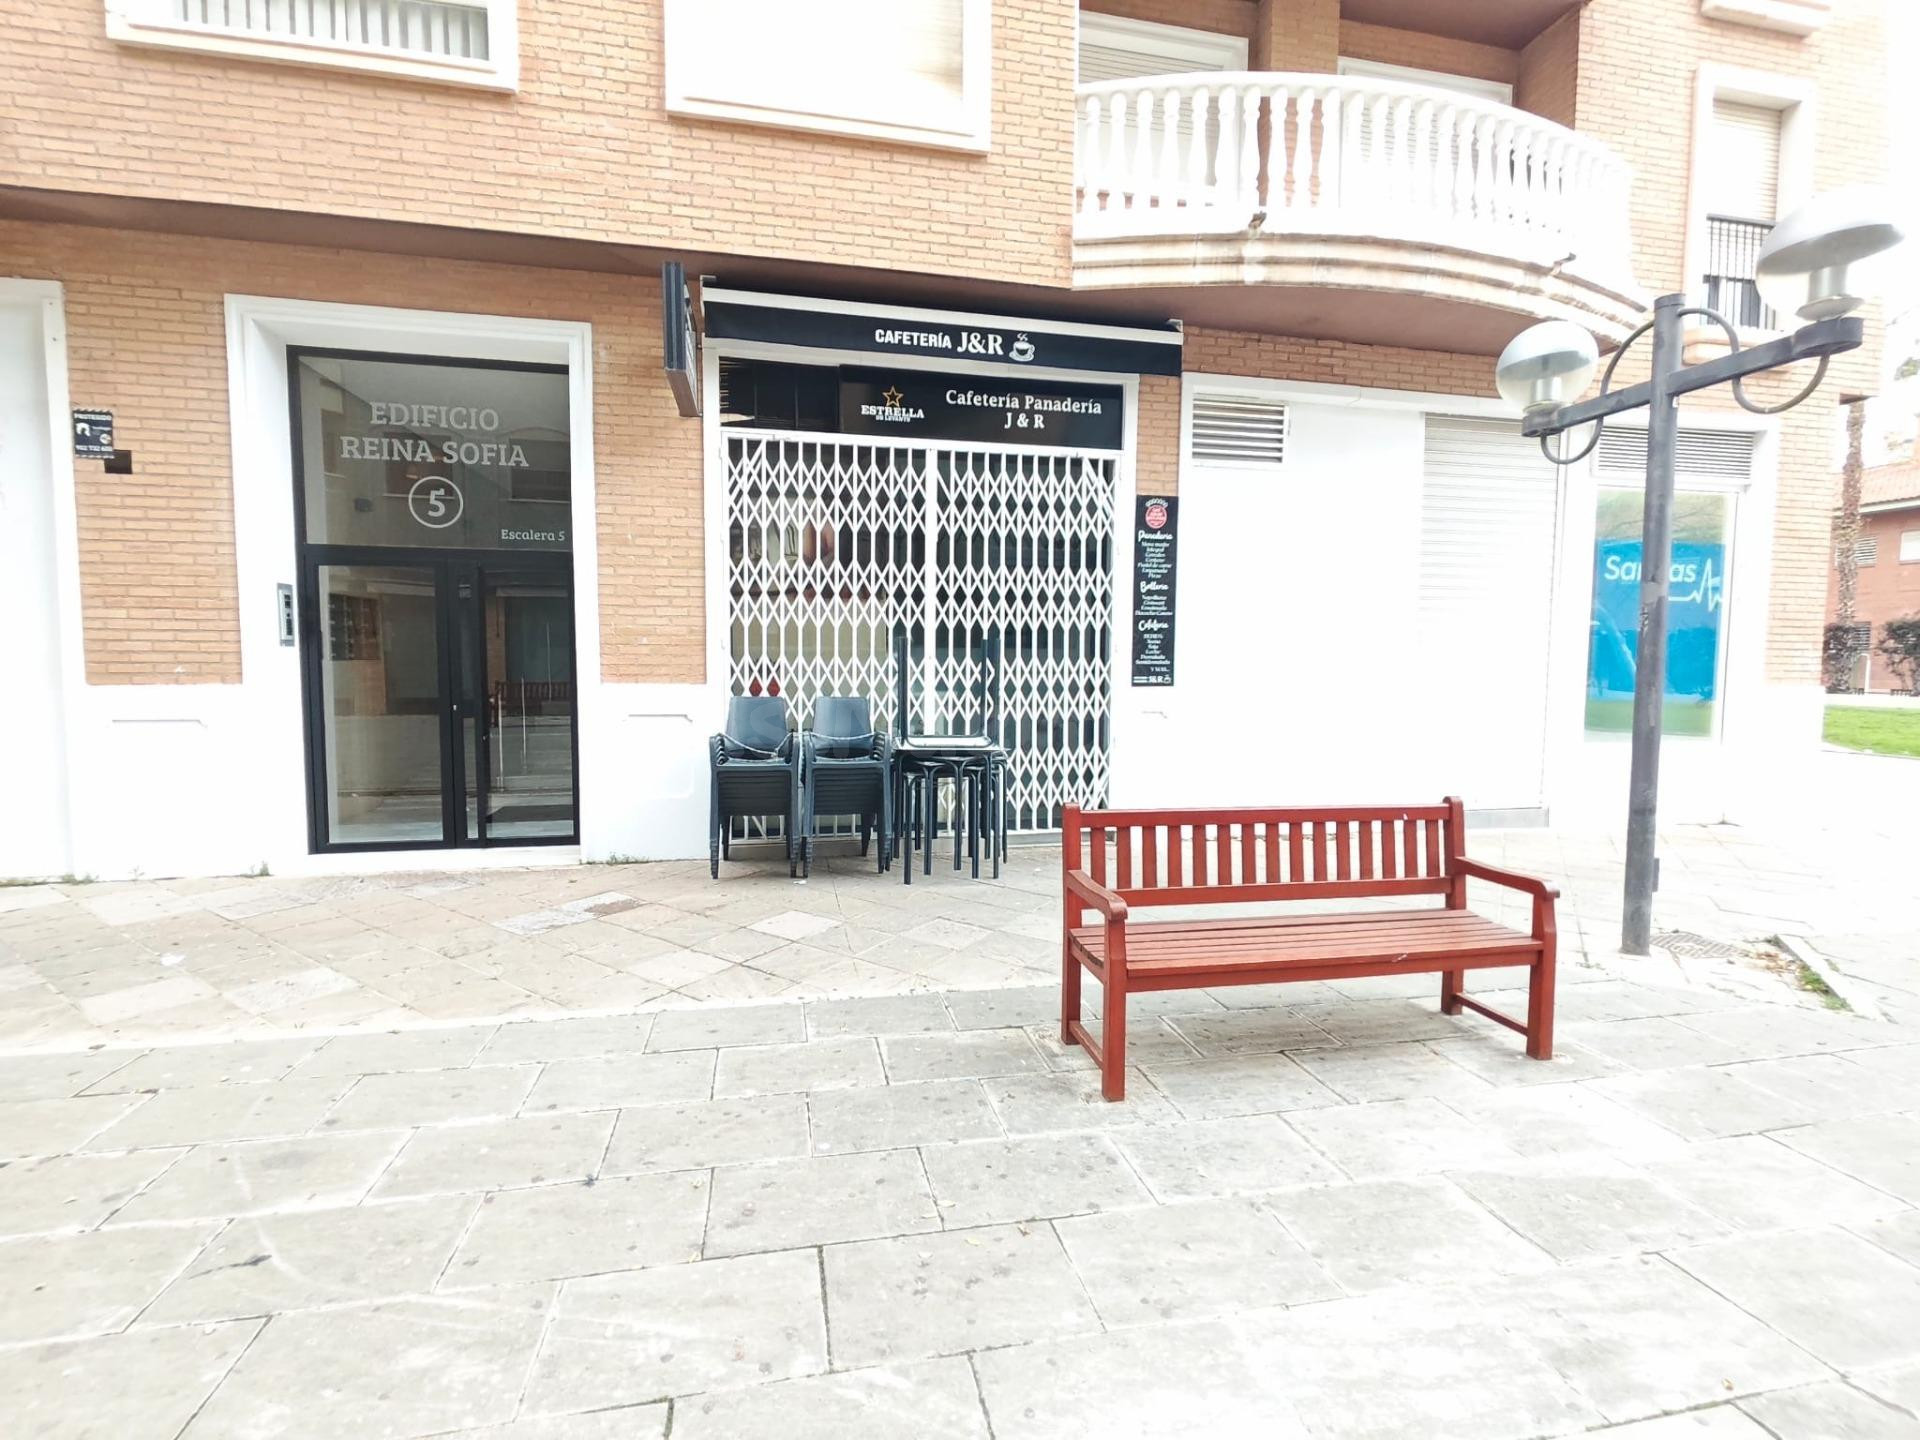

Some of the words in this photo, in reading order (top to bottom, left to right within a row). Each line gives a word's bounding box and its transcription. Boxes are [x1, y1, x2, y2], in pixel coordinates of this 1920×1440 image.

[875, 329, 952, 349] CAFETERÍA
[957, 332, 1004, 355] J&R
[861, 405, 925, 419] ESTRELLA
[946, 390, 1019, 409] Cafetería
[1024, 395, 1102, 414] Panadería
[370, 401, 499, 431] EDIFICIO
[340, 436, 435, 463] REINA
[443, 441, 530, 467] SOFIA
[428, 488, 446, 518] 5
[501, 529, 556, 541] Escalera
[558, 531, 566, 541] 5
[1604, 555, 1697, 583] Saas
